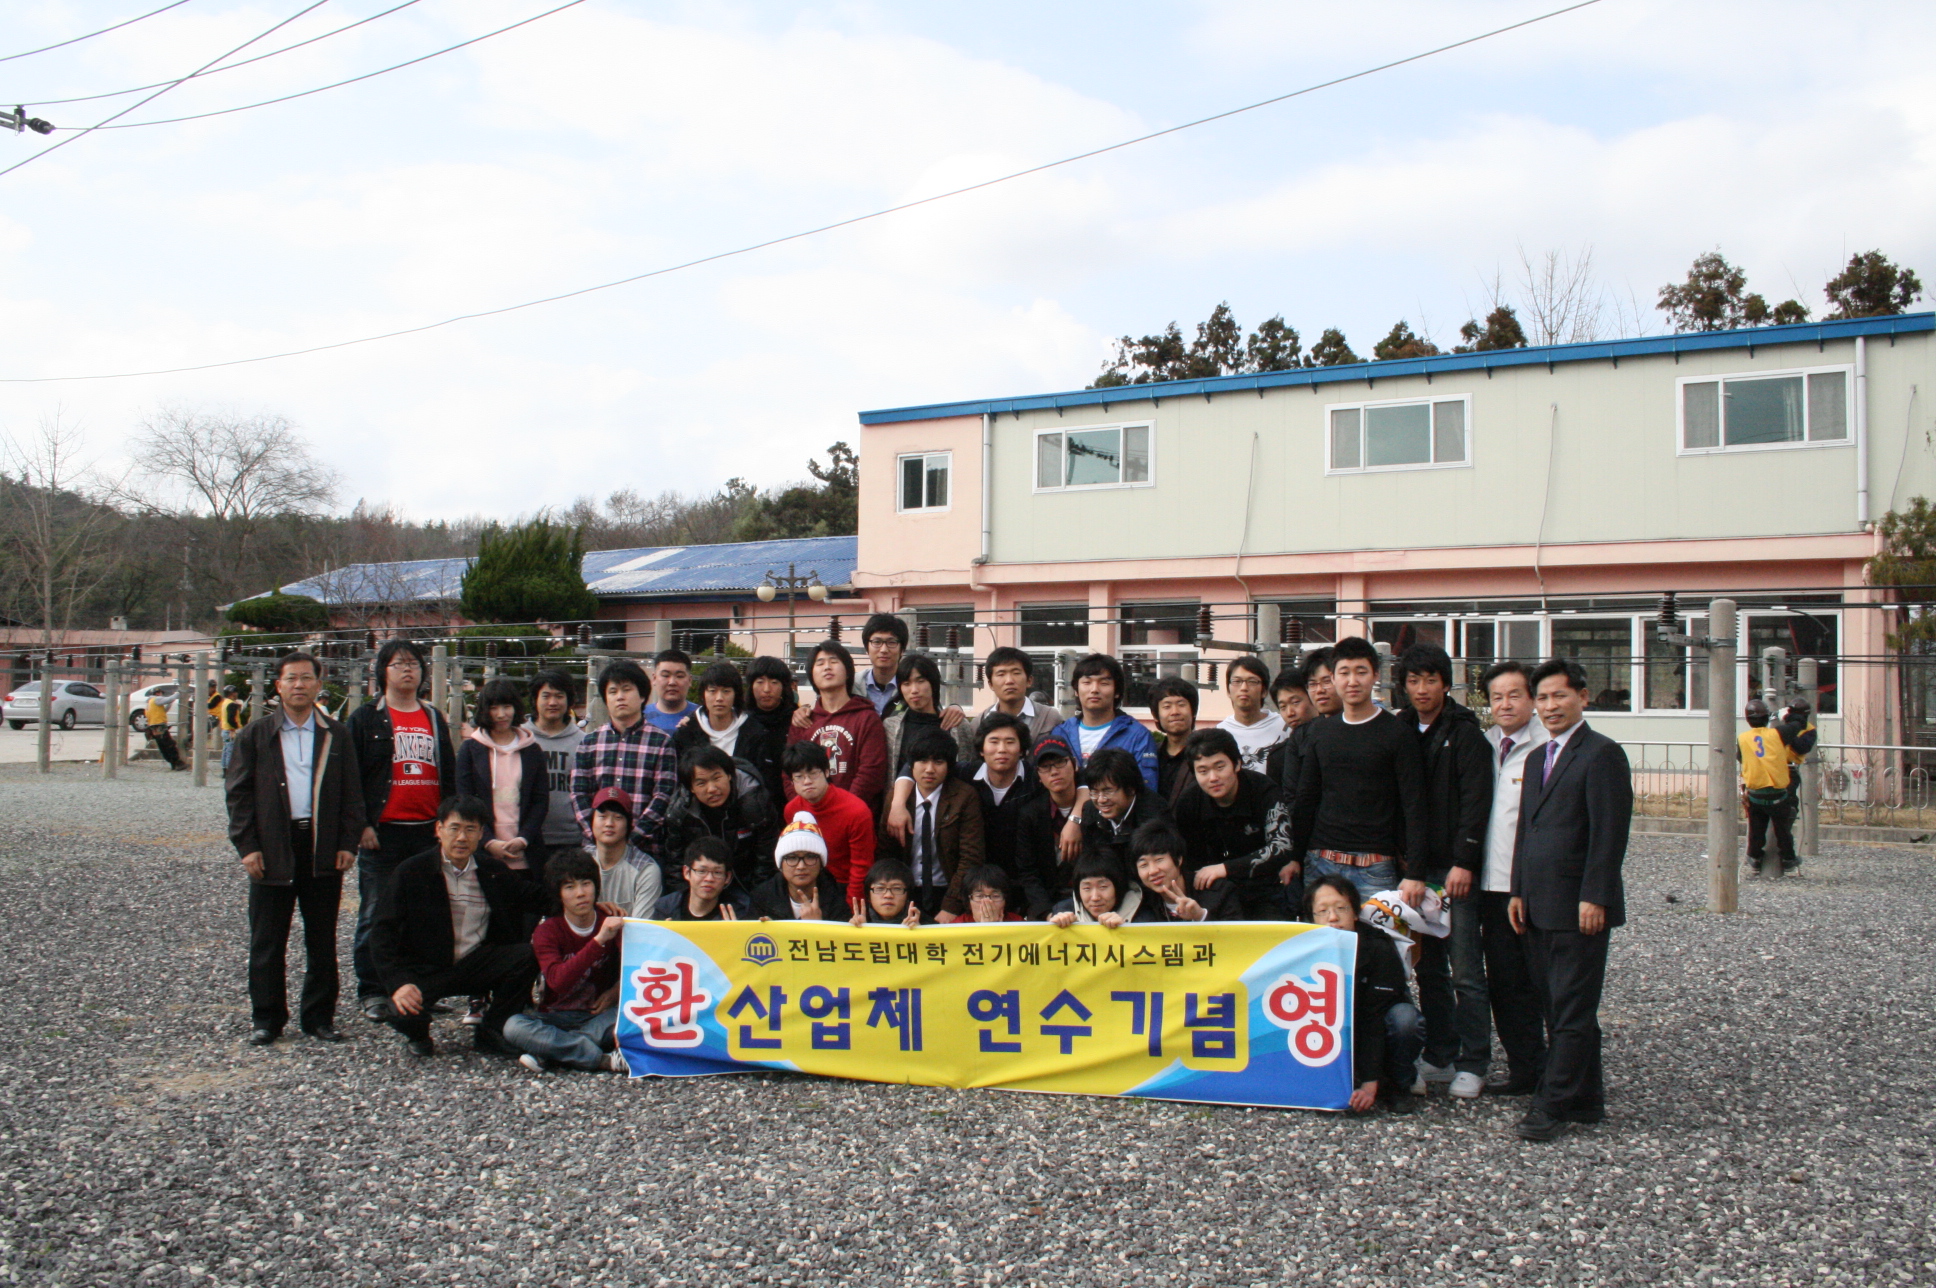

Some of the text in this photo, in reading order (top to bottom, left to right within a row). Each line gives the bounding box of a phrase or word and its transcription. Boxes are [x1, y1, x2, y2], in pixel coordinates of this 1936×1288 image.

[1754, 736, 1764, 758] 3
[788, 939, 1216, 967] 전남도립대학 전기에너지시스템과
[630, 962, 706, 1041] 환
[727, 984, 1236, 1059] 산업체 연수기념
[1269, 969, 1338, 1059] 영
